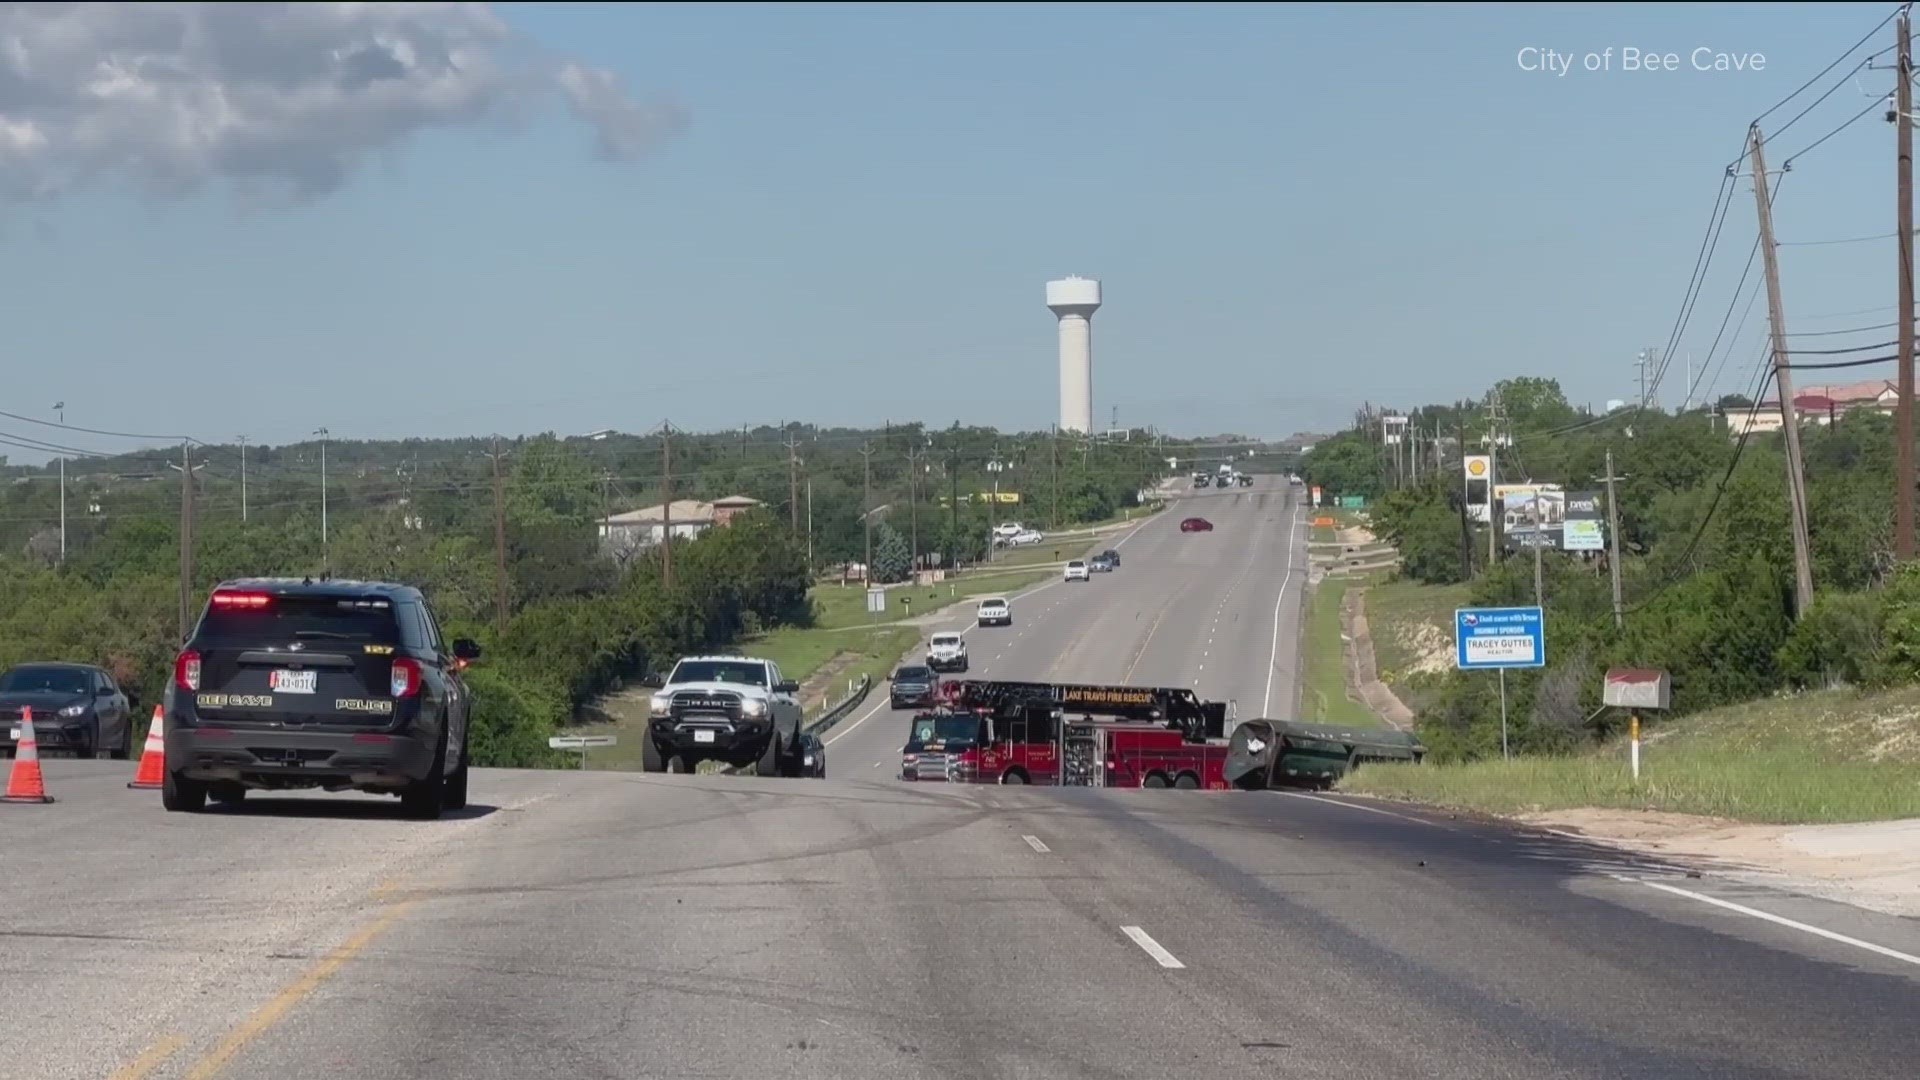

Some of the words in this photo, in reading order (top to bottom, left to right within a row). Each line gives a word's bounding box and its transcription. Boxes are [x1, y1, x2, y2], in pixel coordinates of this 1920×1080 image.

[1468, 640, 1499, 648] TRACEY
[197, 694, 228, 706] BEE
[229, 695, 272, 707] CAVE
[1065, 690, 1082, 700] LAKE
[1083, 691, 1106, 701] TRAVIS
[1107, 692, 1123, 702] FIRE
[335, 699, 392, 712] POLICE
